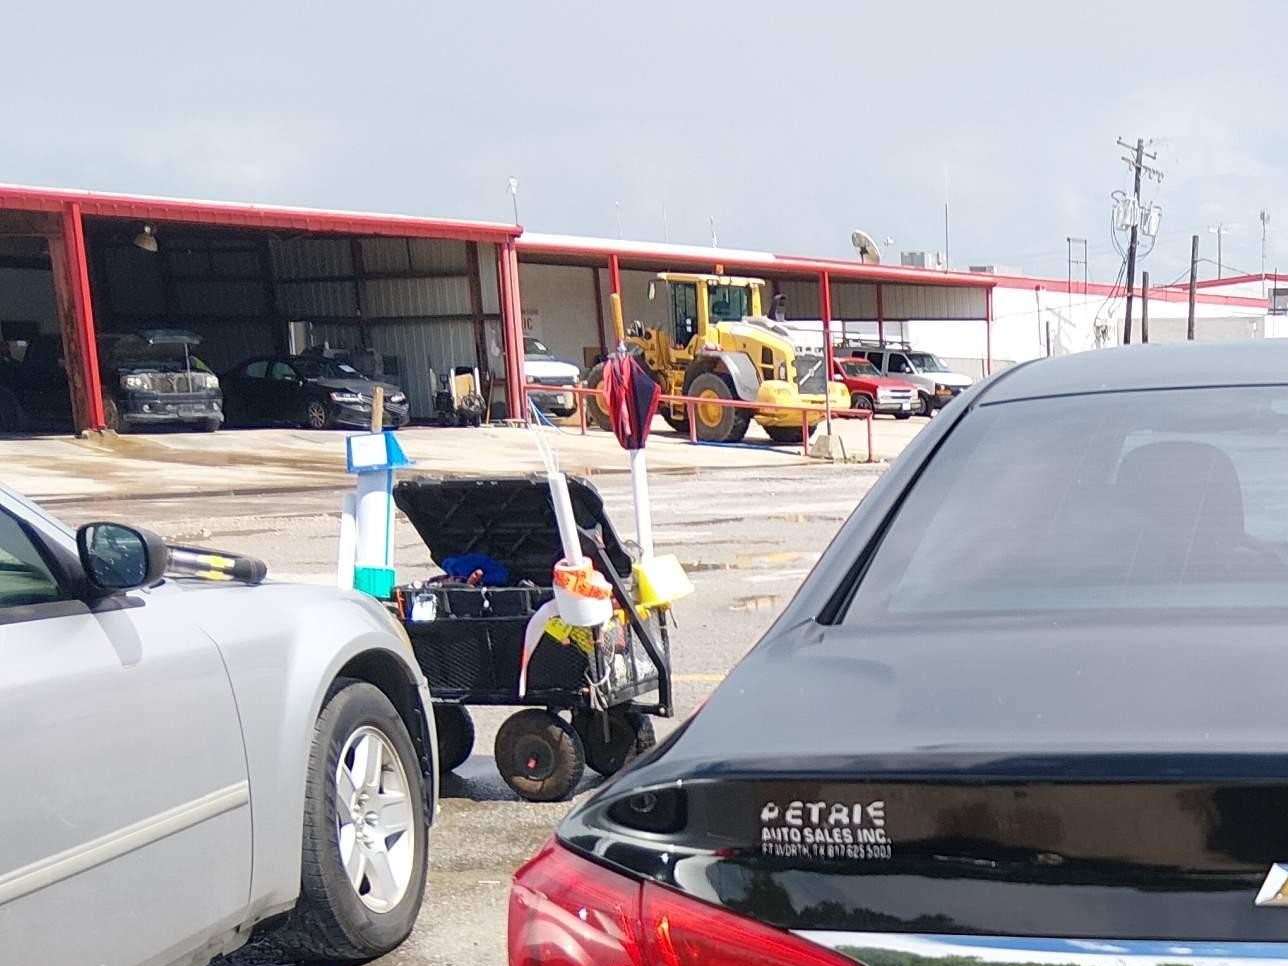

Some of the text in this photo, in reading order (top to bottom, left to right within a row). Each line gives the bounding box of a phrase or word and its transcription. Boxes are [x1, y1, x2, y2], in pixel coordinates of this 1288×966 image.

[761, 800, 885, 826] PETRIE
[761, 827, 892, 844] AUTO SALES INC.
